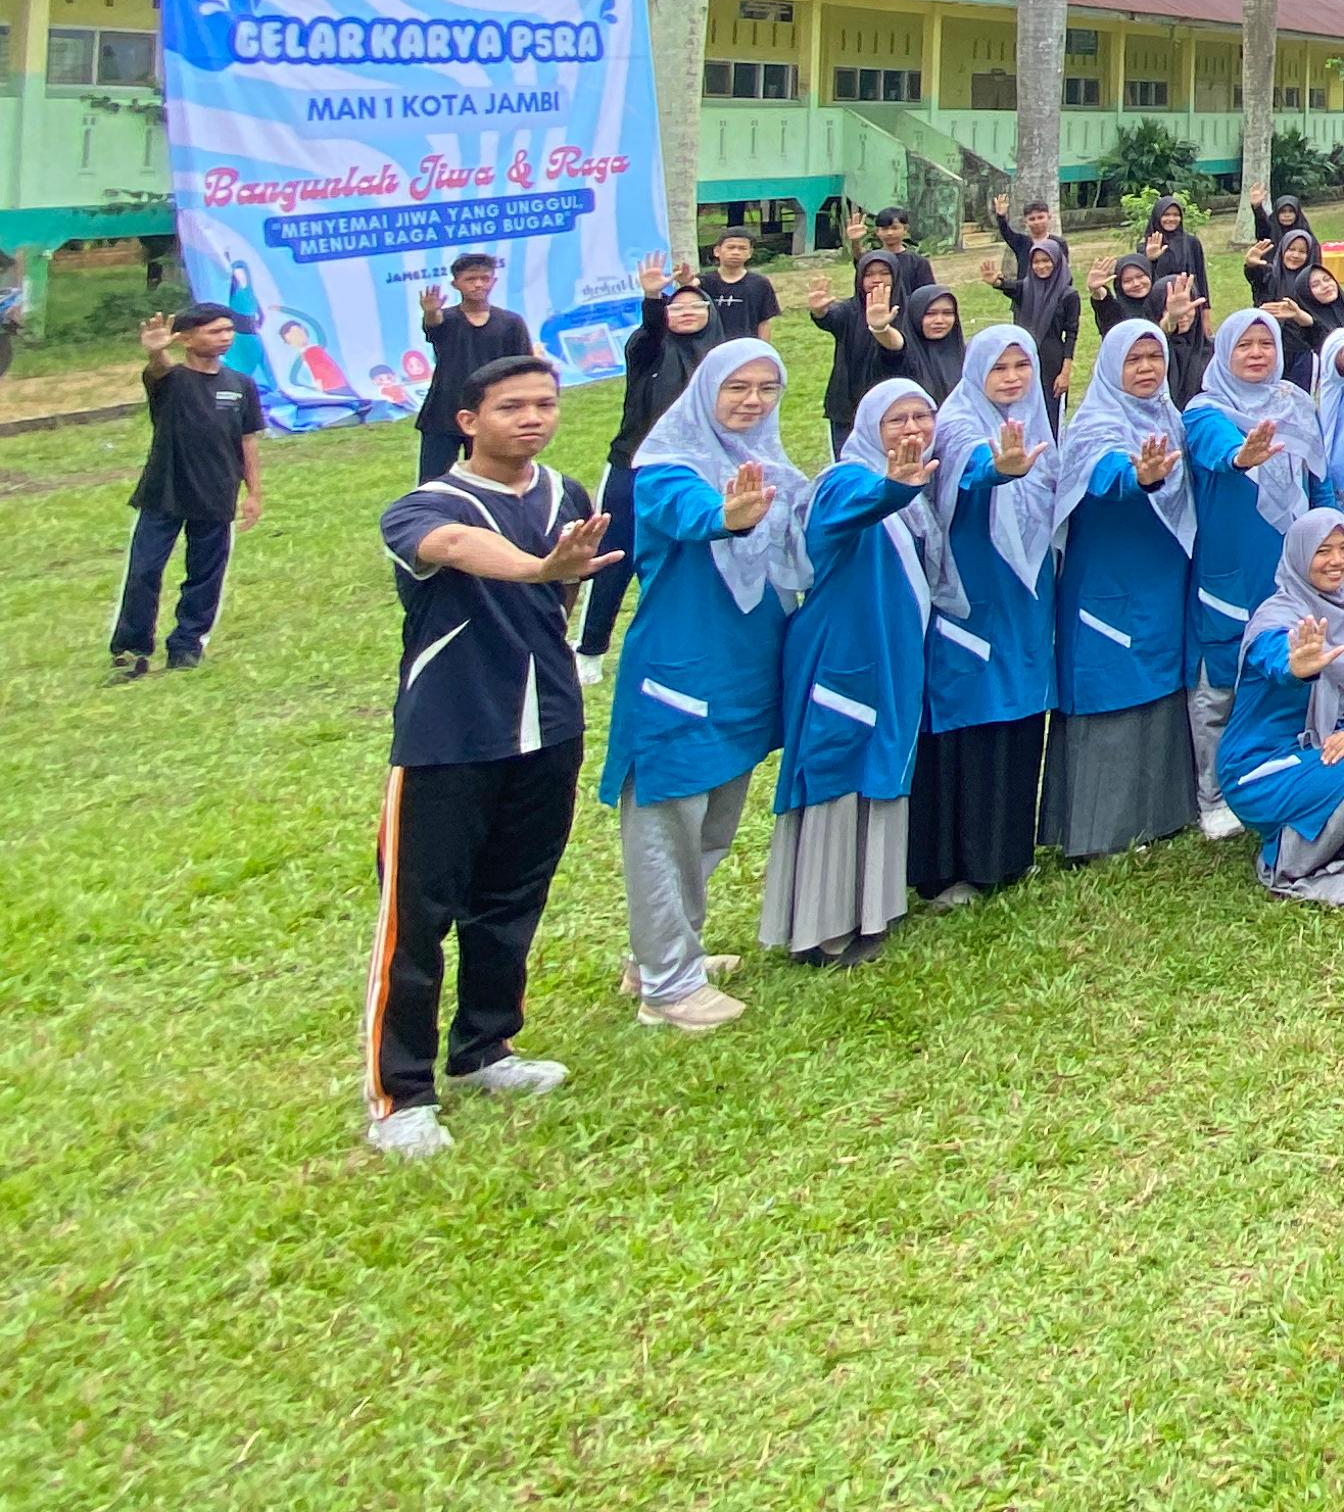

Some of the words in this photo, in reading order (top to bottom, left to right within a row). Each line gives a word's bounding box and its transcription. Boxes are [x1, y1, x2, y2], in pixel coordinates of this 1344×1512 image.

[233, 19, 366, 61] GELAR
[370, 21, 502, 61] KARYA
[510, 23, 600, 62] P5RA
[307, 95, 375, 122] MAN
[384, 96, 393, 119] 1
[402, 93, 478, 119] KOTA
[484, 91, 560, 116] JAMBI
[204, 163, 399, 213] Bangunlah
[409, 154, 495, 201] Jiwa
[506, 149, 534, 189] &
[545, 146, 630, 184] Raga
[395, 209, 439, 230] JIWA
[448, 203, 499, 223] YANG
[300, 235, 378, 257] MENUAI
[385, 226, 439, 248] RAGA
[444, 219, 495, 241] YANG
